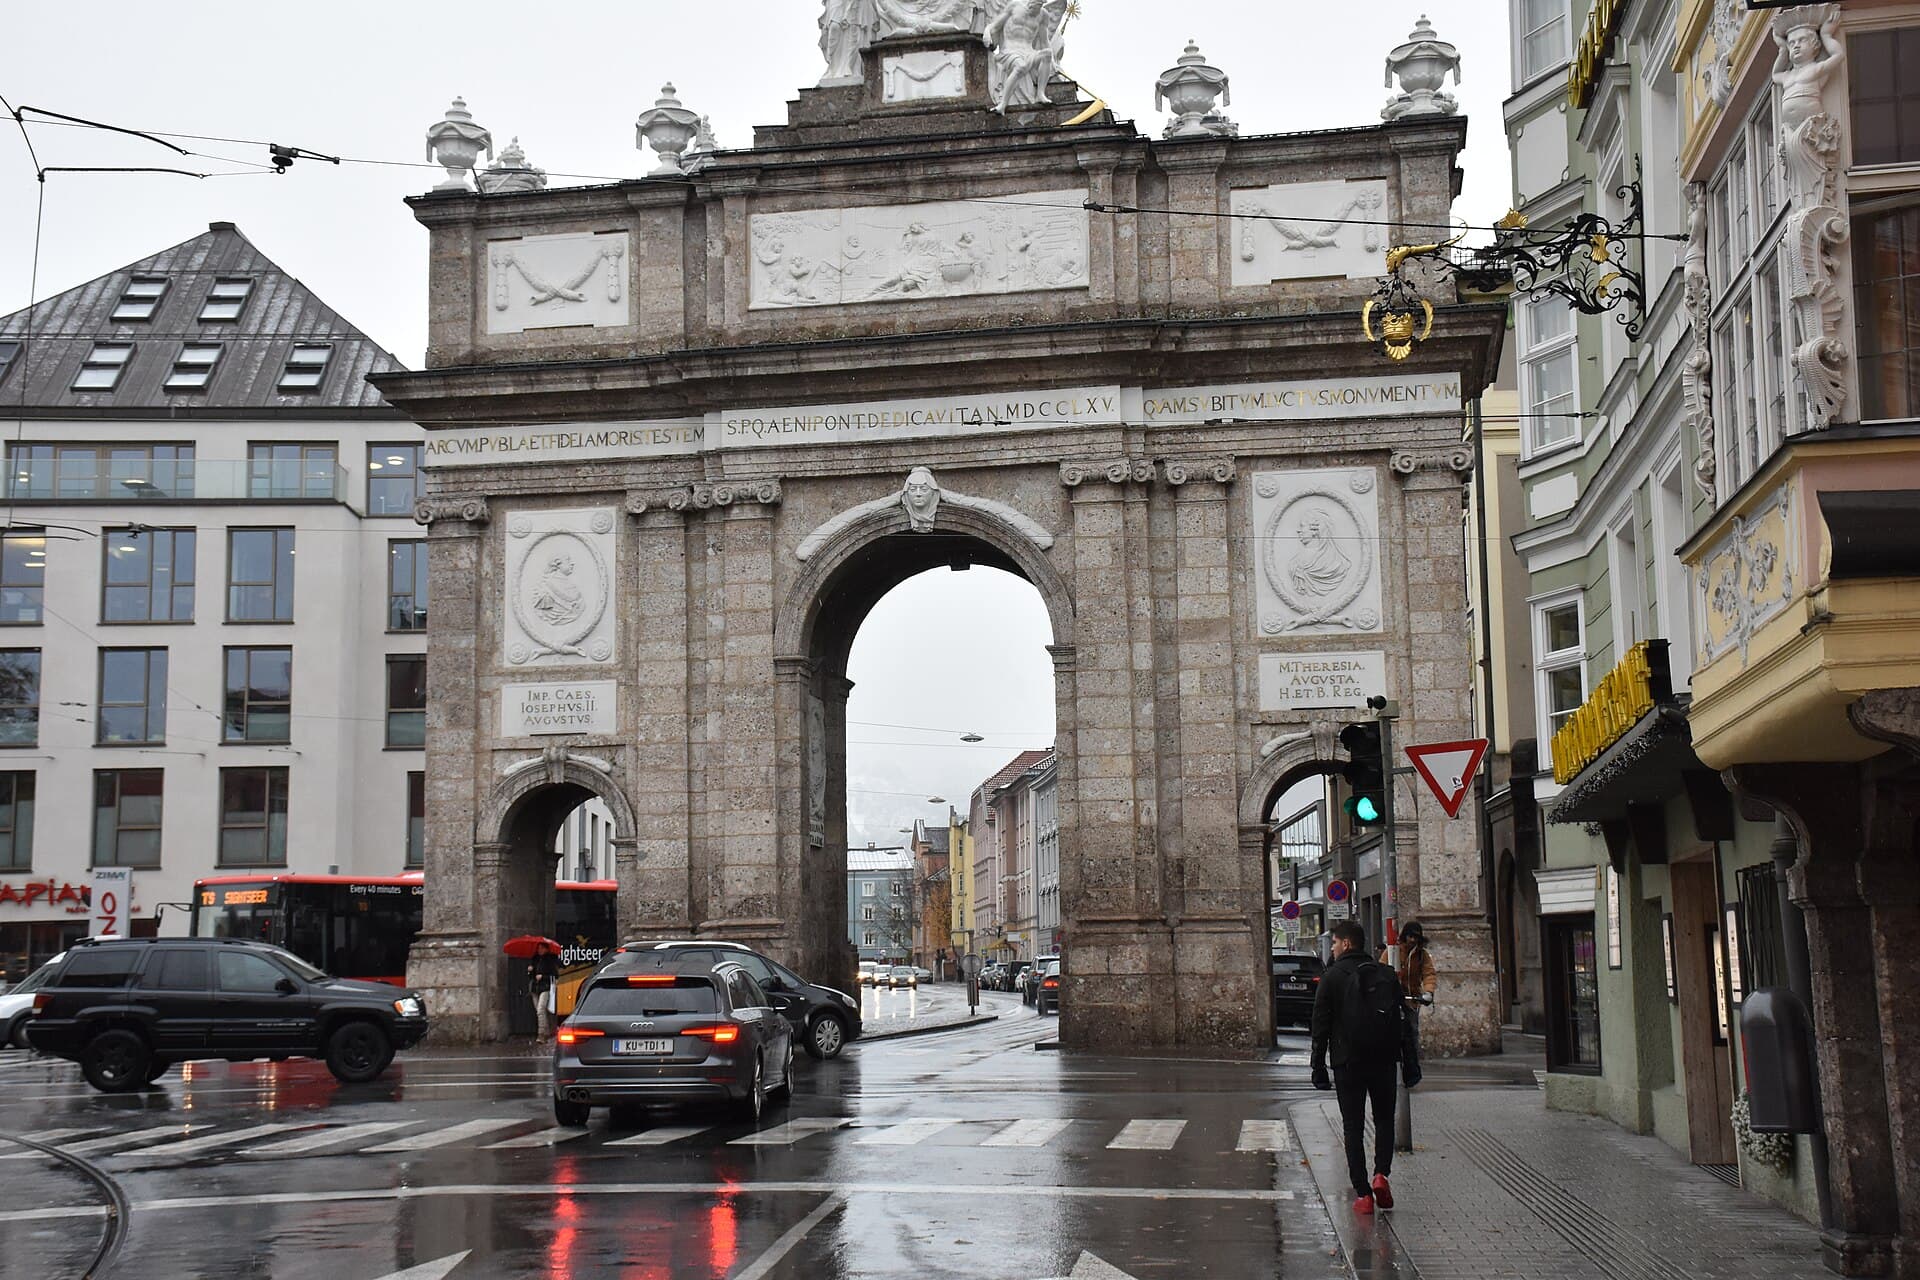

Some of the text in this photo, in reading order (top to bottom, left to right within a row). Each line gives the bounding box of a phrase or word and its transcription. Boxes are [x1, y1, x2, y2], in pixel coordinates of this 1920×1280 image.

[350, 884, 368, 897] Every
[367, 885, 376, 895] 40
[376, 885, 401, 895] minutes
[558, 944, 603, 966] ightseer
[625, 1041, 638, 1051] KU
